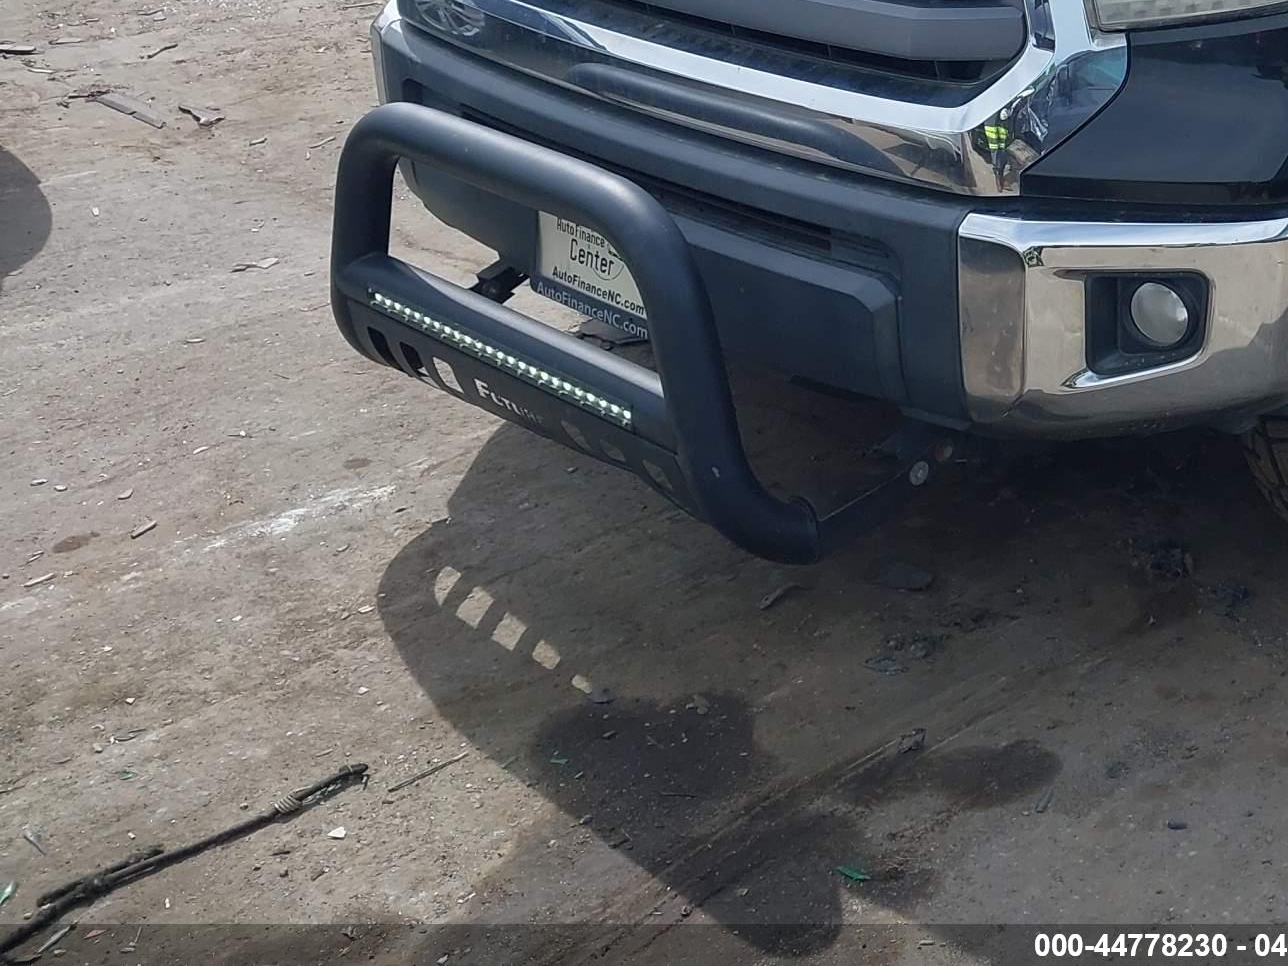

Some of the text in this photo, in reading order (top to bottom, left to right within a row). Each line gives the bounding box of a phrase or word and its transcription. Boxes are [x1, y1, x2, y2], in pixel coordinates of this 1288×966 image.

[570, 238, 614, 275] Center
[536, 281, 648, 339] AutoFinanceNC.com
[552, 265, 645, 315] AutoFinanceNC.com
